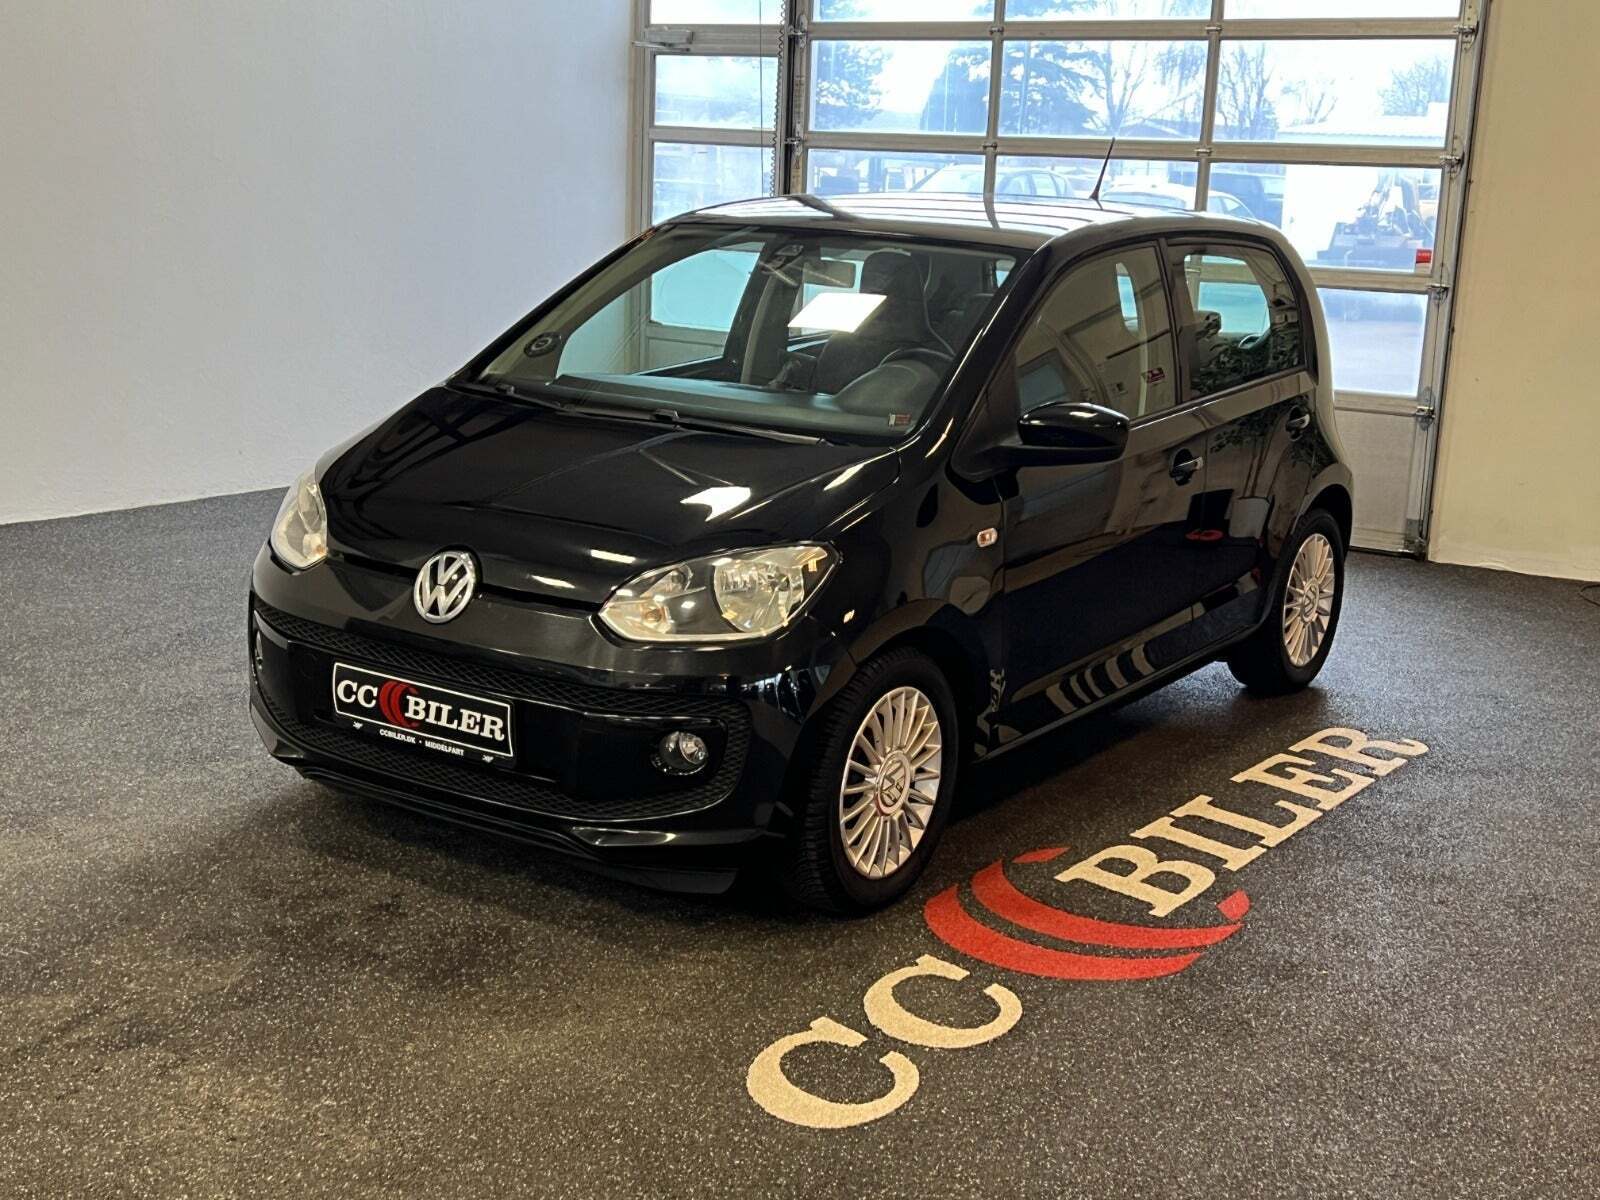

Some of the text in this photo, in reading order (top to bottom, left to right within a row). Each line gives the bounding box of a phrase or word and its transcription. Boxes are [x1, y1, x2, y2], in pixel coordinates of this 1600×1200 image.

[337, 680, 505, 742] CC BILER
[424, 739, 465, 756] MIDDELFART
[746, 726, 1429, 1129] CC BILER
